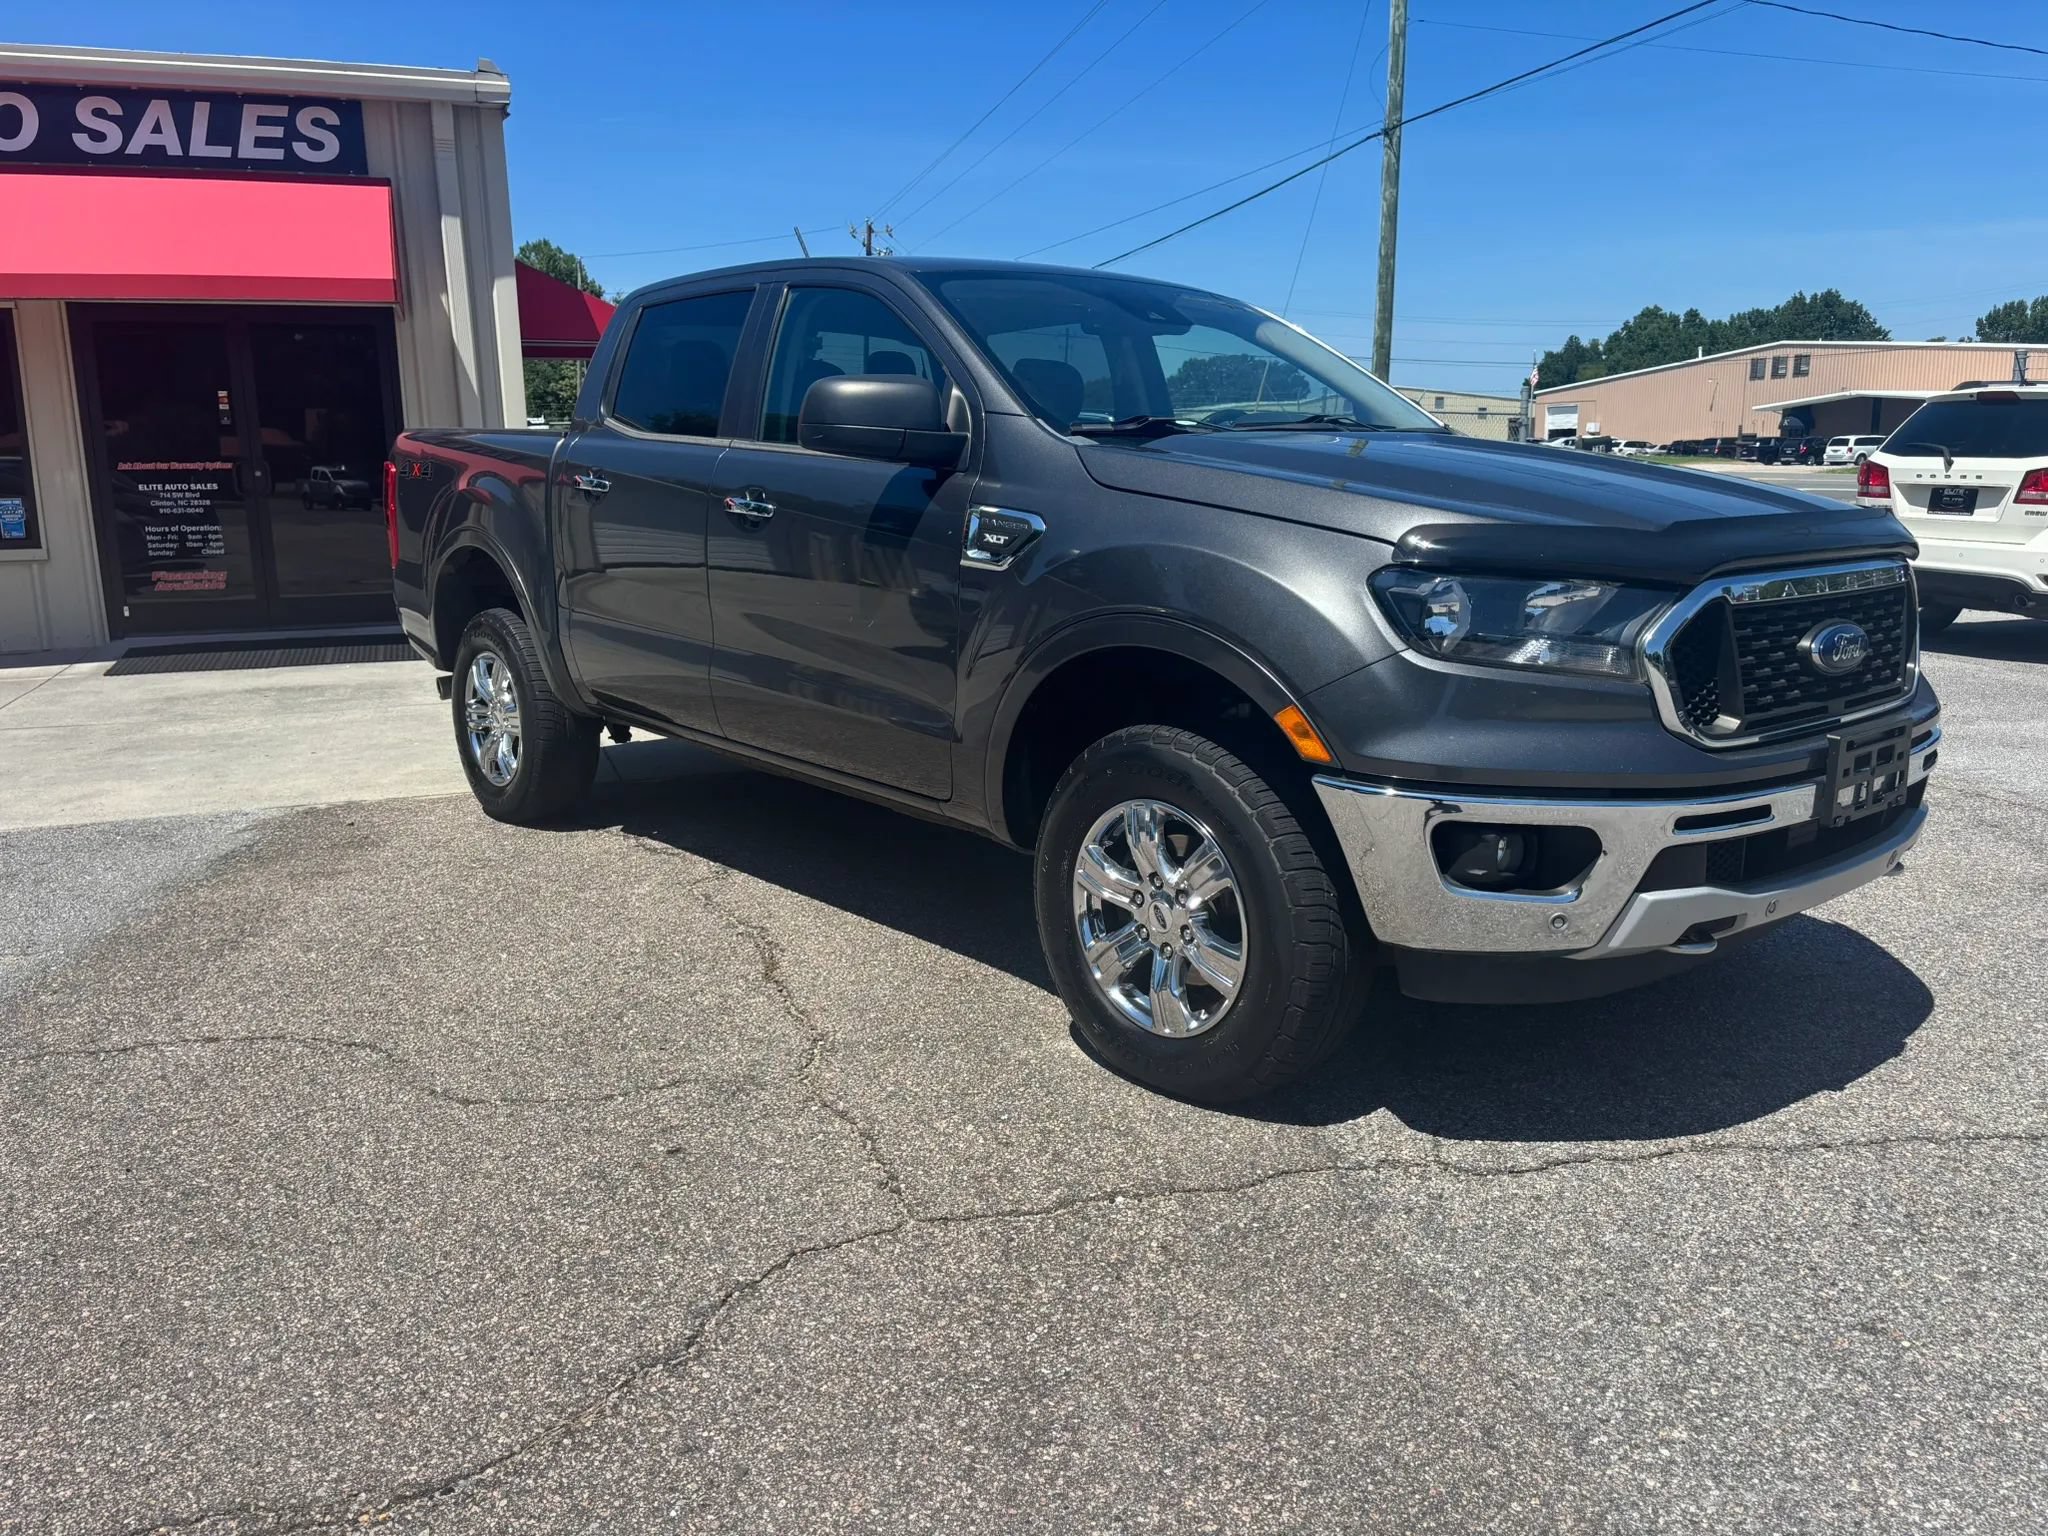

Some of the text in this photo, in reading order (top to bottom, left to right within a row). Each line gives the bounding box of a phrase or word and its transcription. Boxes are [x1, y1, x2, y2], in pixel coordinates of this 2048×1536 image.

[72, 95, 341, 164] SALES
[164, 483, 189, 491] AUTO
[190, 483, 218, 491] SALES
[145, 524, 223, 534] Hours of Operation:
[981, 517, 1028, 530] RANGER
[983, 533, 1009, 545] XLT
[147, 542, 180, 550] Saturday:
[148, 548, 225, 557] Sunday: Closed
[151, 570, 227, 581] Financing
[154, 580, 225, 591] Available
[1832, 633, 1865, 662] Ford
